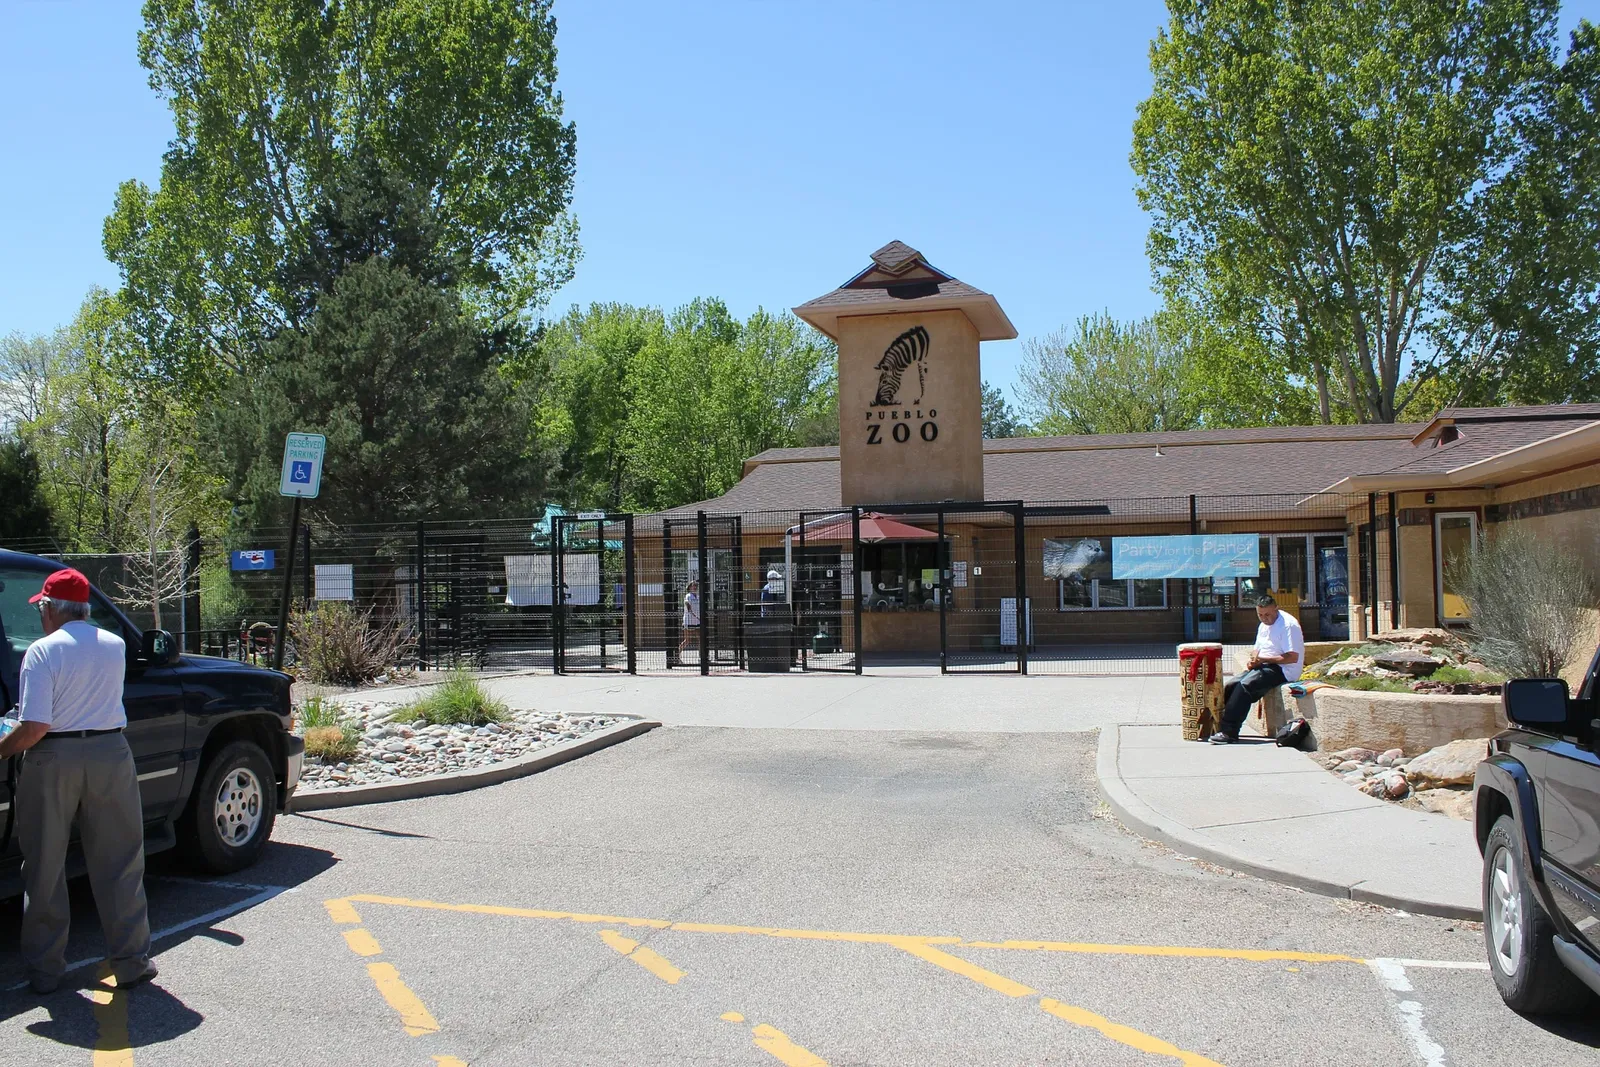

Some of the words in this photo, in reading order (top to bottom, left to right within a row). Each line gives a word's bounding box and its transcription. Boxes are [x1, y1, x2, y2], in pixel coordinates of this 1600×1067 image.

[866, 409, 937, 420] PUEBLO
[866, 421, 939, 445] ZOO
[288, 439, 322, 449] RESERVED
[289, 449, 319, 460] PARKING
[239, 550, 265, 559] PEPSI
[1119, 543, 1163, 558] Party
[1164, 546, 1180, 556] for
[1183, 545, 1201, 556] the
[1202, 541, 1254, 555] Planet
